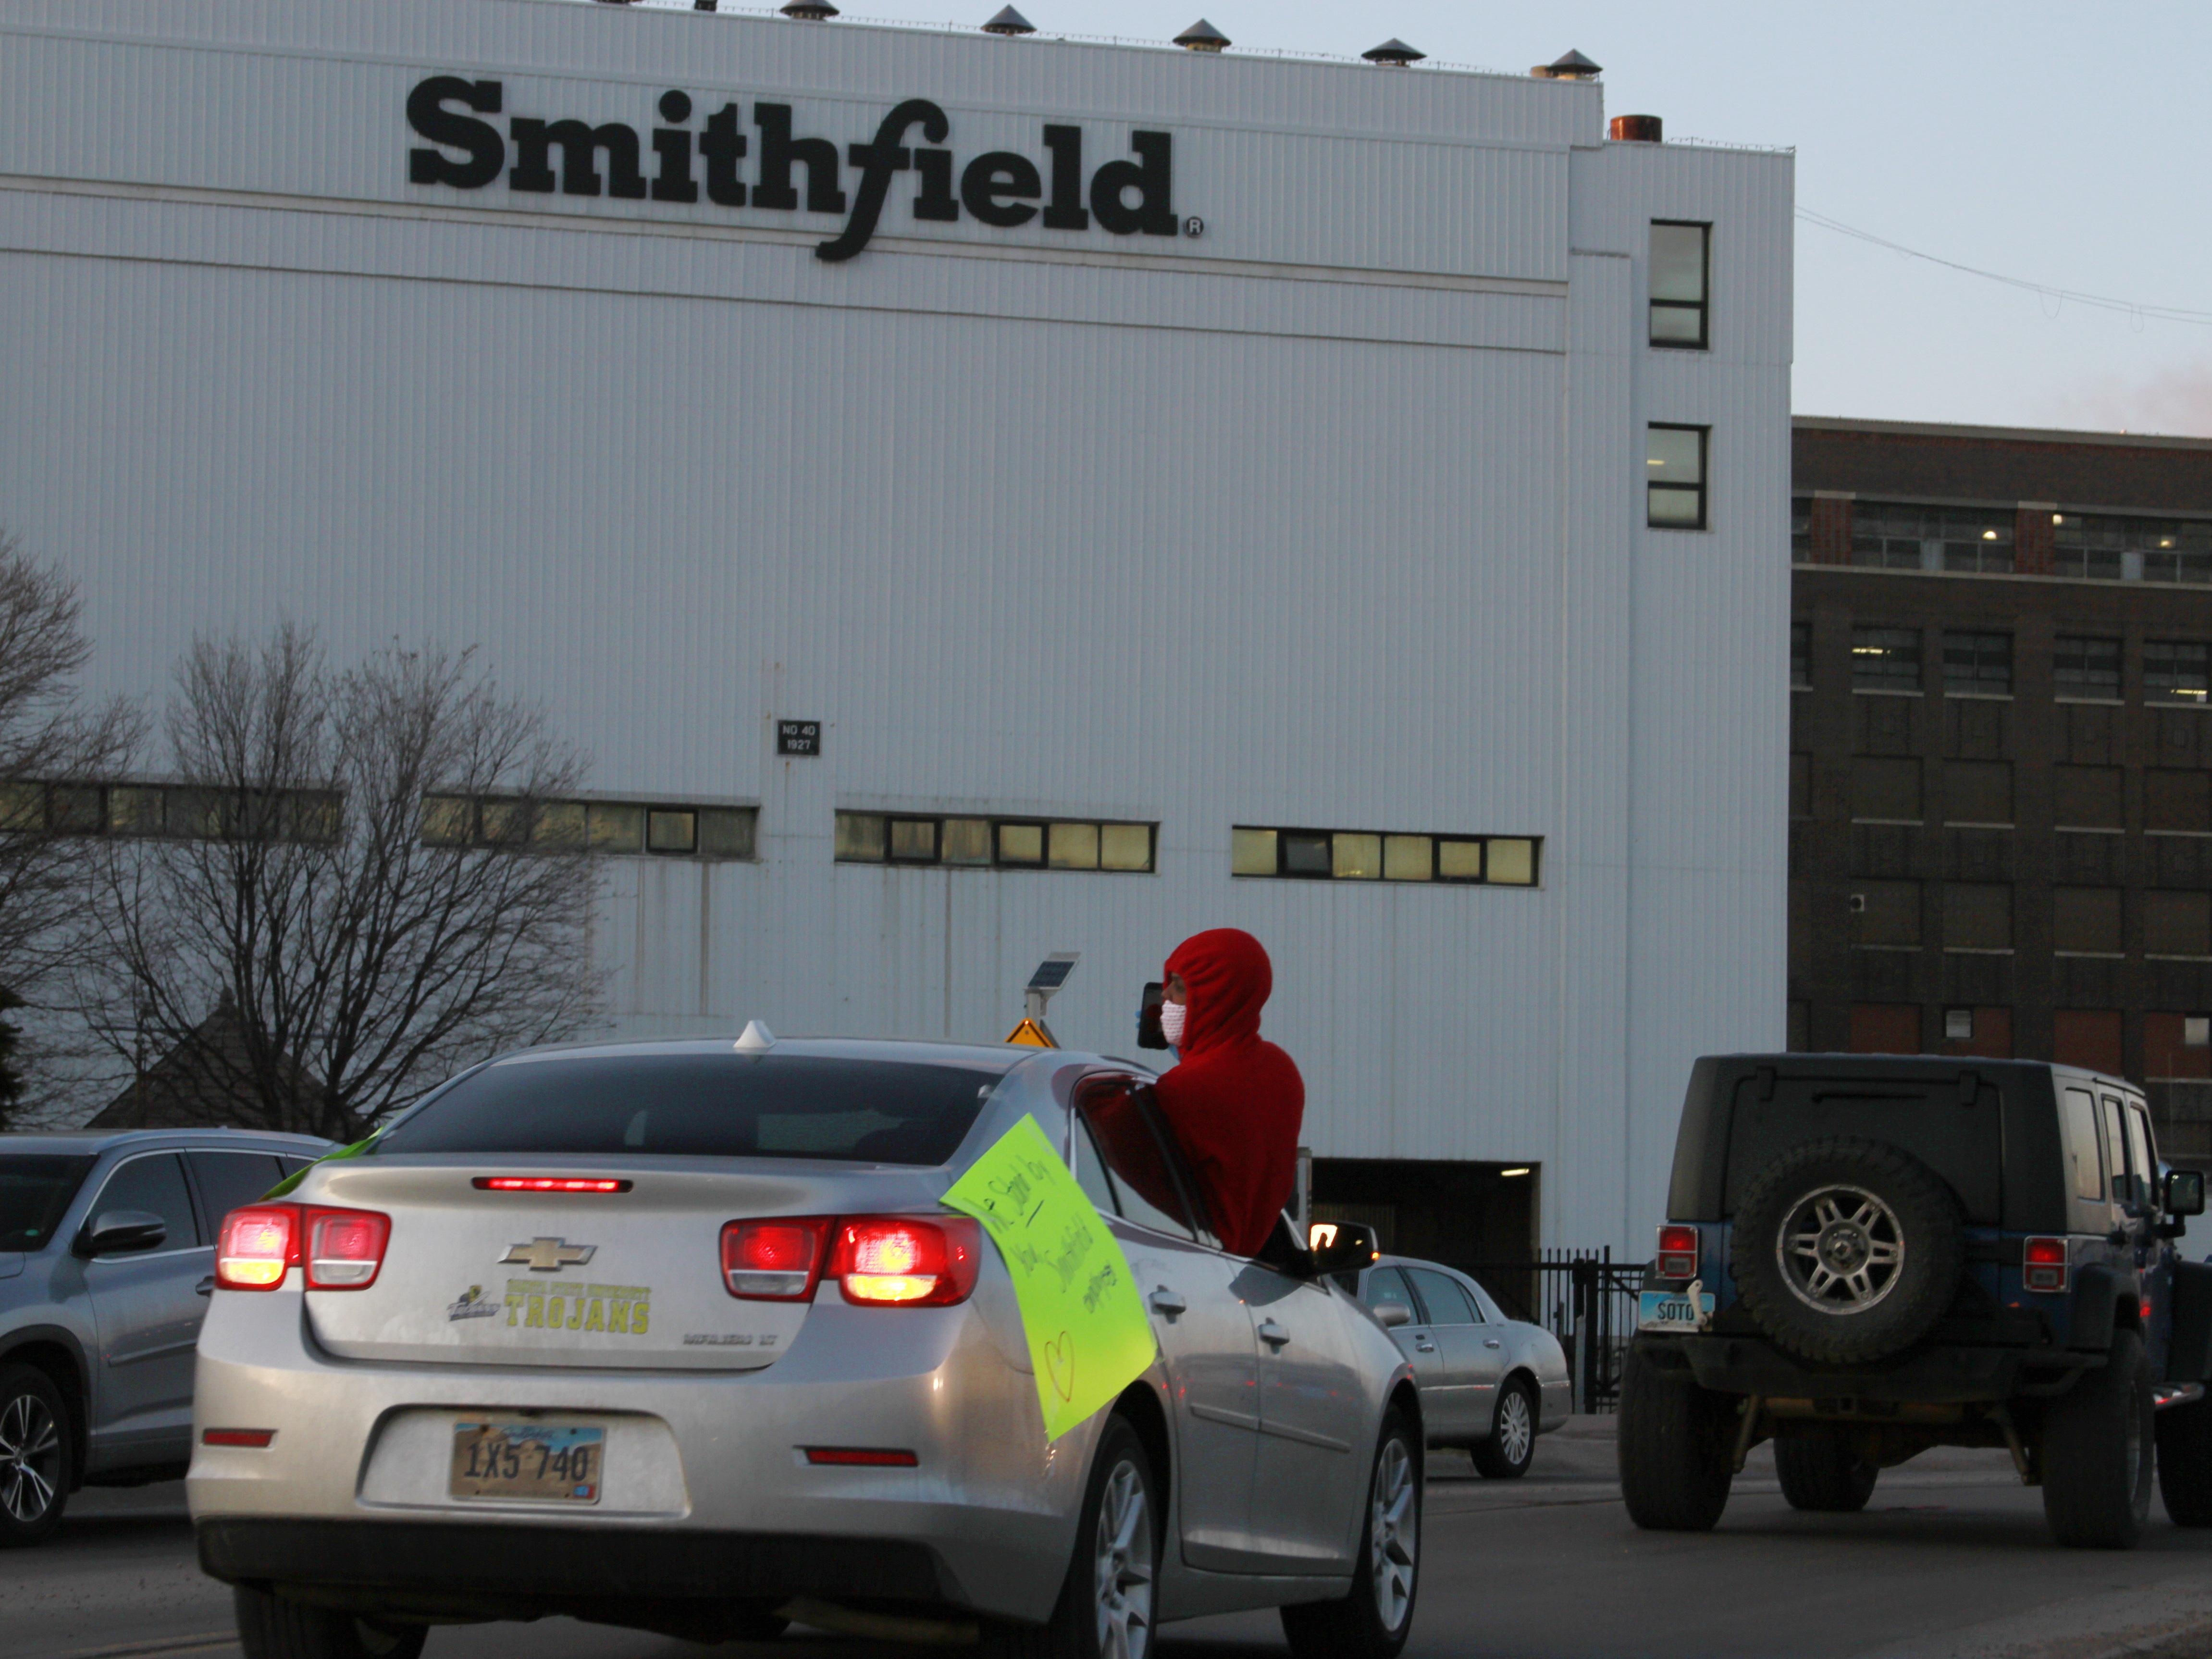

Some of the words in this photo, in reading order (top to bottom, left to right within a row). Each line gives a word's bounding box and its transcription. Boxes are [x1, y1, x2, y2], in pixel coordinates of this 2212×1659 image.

[407, 75, 1178, 261] Smithfield
[787, 739, 811, 750] 1927
[802, 725, 816, 736] 40
[505, 1294, 650, 1334] TROJANS
[464, 1442, 521, 1479] 1X5
[534, 1444, 588, 1481] 740
